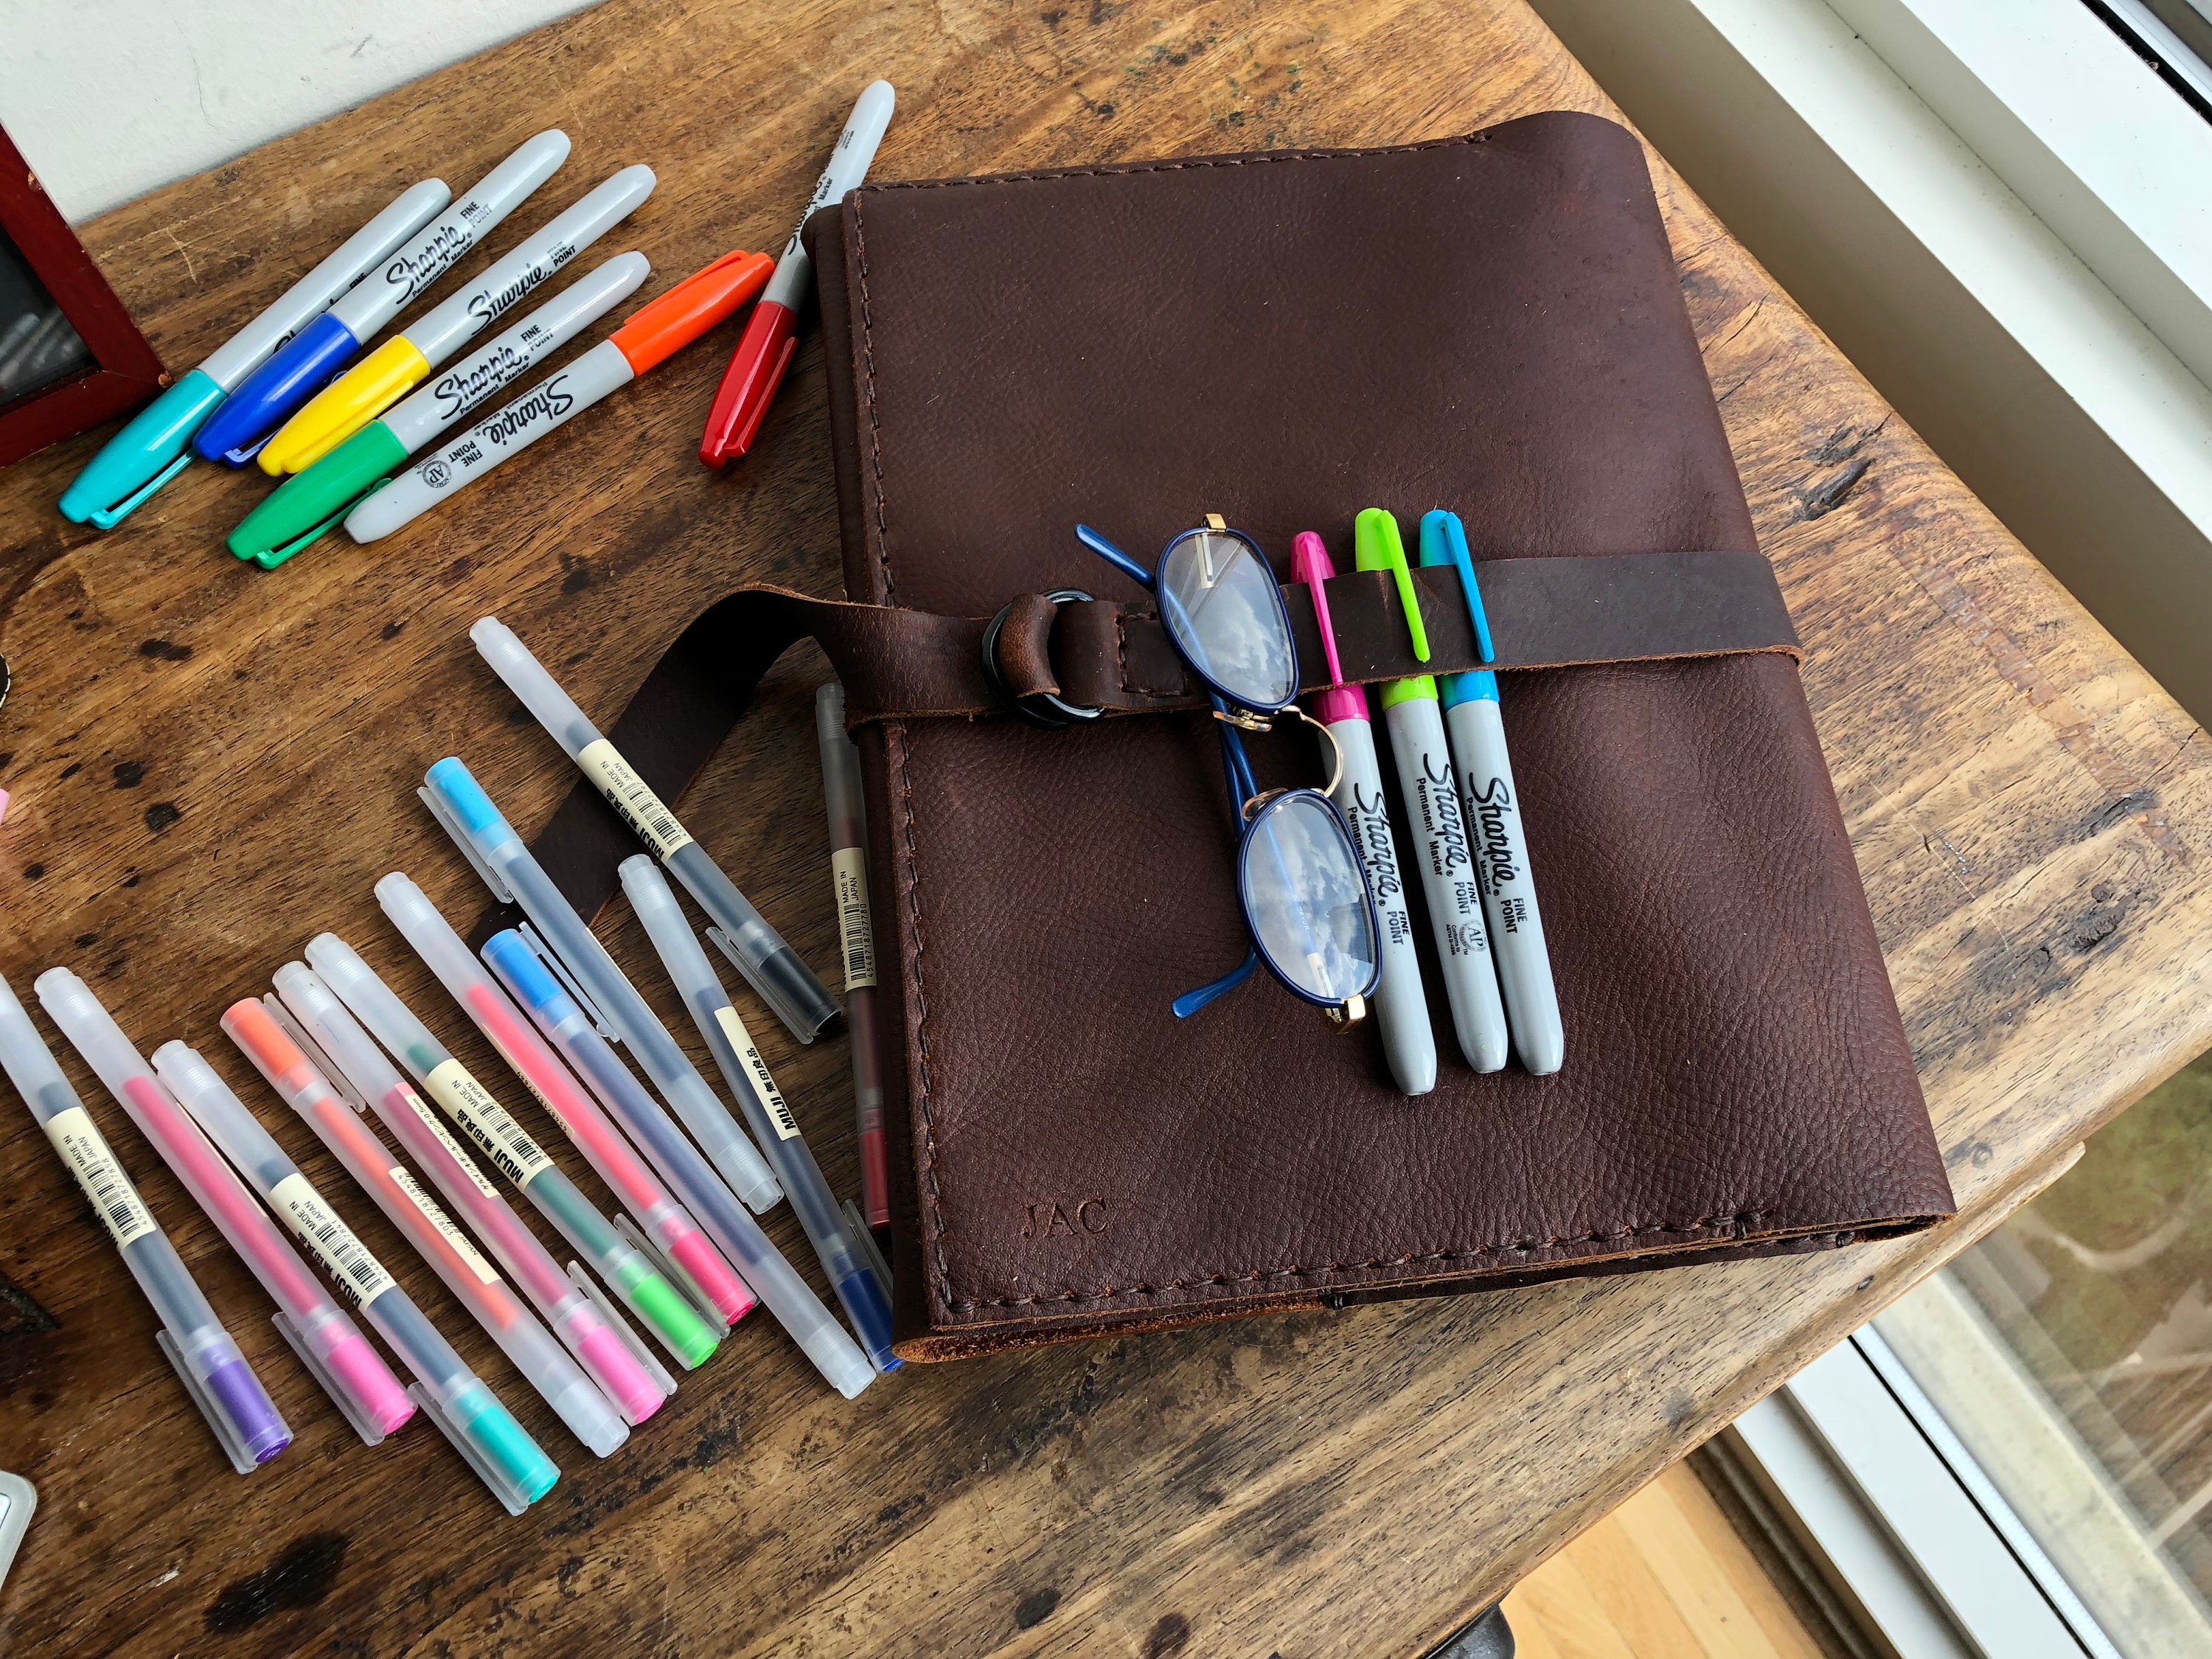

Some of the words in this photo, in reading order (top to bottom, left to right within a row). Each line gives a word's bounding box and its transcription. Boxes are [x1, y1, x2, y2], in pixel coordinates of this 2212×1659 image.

[818, 178, 833, 200] Marker
[460, 201, 480, 219] FINE
[468, 204, 493, 228] POINT
[386, 226, 465, 305] Sharpie
[412, 263, 447, 297] Permanent
[451, 240, 473, 262] Marker
[553, 245, 576, 267] POINT
[467, 262, 546, 335] Sharpie
[521, 324, 542, 342] FINE
[434, 347, 522, 420] Sharpie
[459, 384, 499, 414] Permanent
[504, 362, 529, 383] Marker
[483, 375, 573, 445] Sharpie
[448, 440, 476, 463] POINT
[461, 449, 483, 467] FINE
[600, 761, 610, 770] IN
[607, 769, 625, 788] MADE
[613, 762, 634, 781] JAPAN
[1423, 753, 1469, 868] Sharpie
[1348, 807, 1368, 860] Permanent
[1354, 782, 1401, 897] Sharpie
[1416, 777, 1435, 832] Permanent
[1428, 840, 1443, 876] Marker
[1469, 772, 1520, 887] Sharpie
[639, 827, 665, 860] MUJI
[1467, 796, 1483, 852] Permanent
[1479, 859, 1492, 895] Marker
[840, 871, 846, 880] IN
[849, 877, 859, 900] JAPAN
[841, 881, 849, 903] MADE
[1454, 882, 1471, 914] POINT
[1467, 882, 1478, 905] FINE
[1399, 911, 1410, 935] FINE
[1500, 899, 1517, 933] POINT
[1513, 897, 1528, 922] FINE
[860, 903, 873, 978] 4548718727780
[1387, 911, 1404, 945] POINT
[451, 1079, 462, 1089] IN
[746, 1047, 776, 1093] 無印良品
[459, 1088, 479, 1108] MADE
[466, 1082, 487, 1100] JAPAN
[770, 1096, 796, 1130] MUJI
[63, 1135, 73, 1145] IN
[457, 1108, 495, 1152] 無印良品
[69, 1144, 87, 1166] MADE
[78, 1136, 97, 1158] JAPAN
[493, 1148, 524, 1184] MUJI
[102, 1158, 147, 1225] 4548718727858
[398, 1175, 453, 1236] 4548718727803
[289, 1201, 299, 1211] IN
[297, 1209, 316, 1231] MADE
[304, 1200, 327, 1222] JAPAN
[1020, 1197, 1108, 1239] JAC
[332, 1220, 388, 1280] 4548718727841
[458, 1235, 479, 1256] JAPAN
[335, 1273, 362, 1308] MUJI
